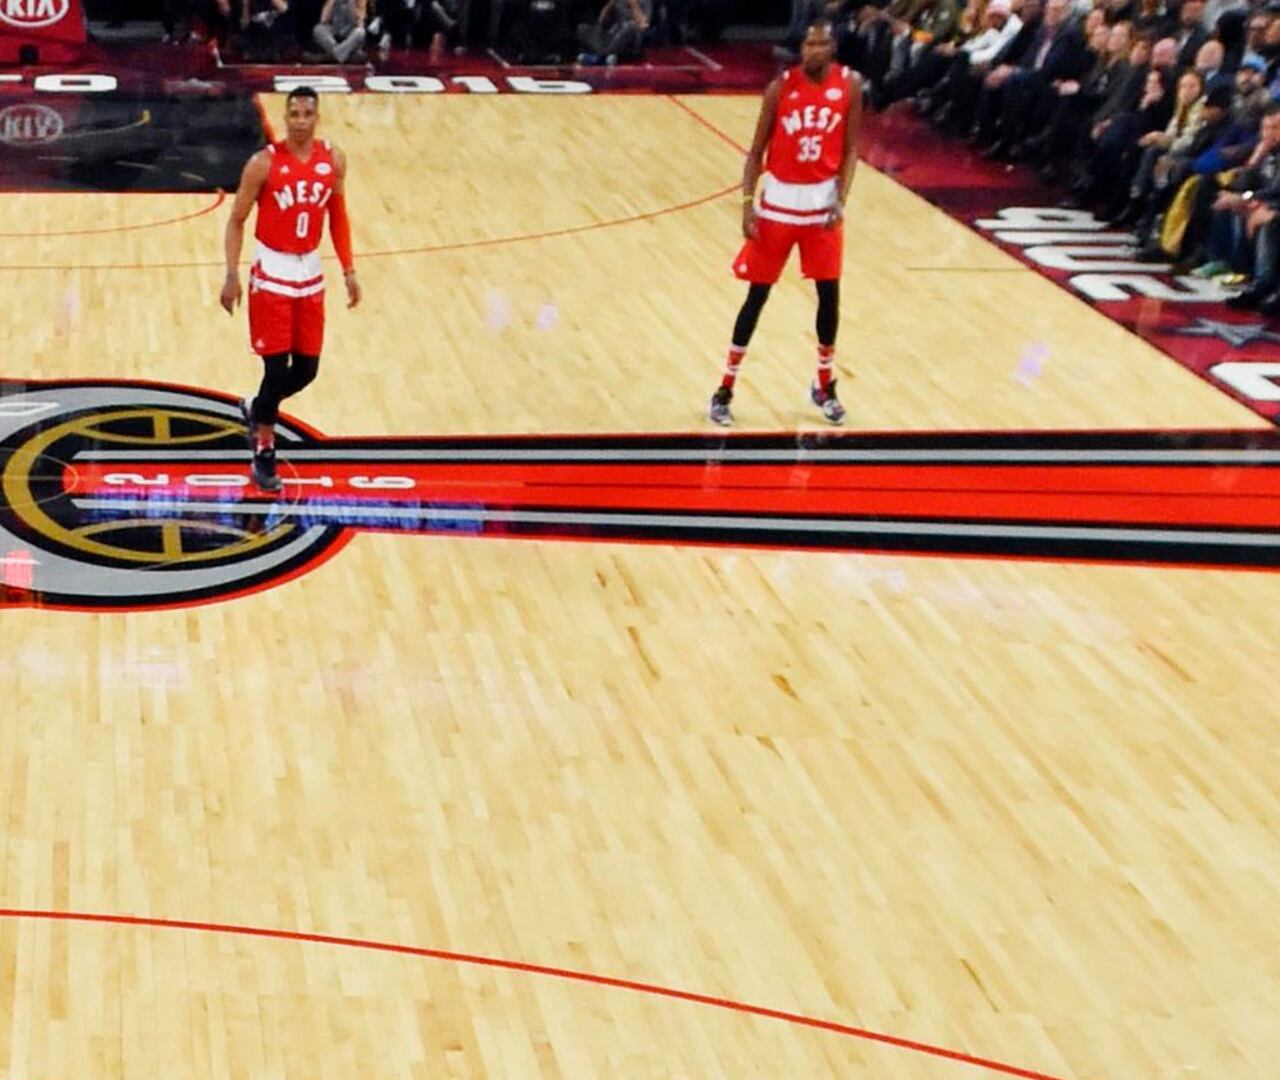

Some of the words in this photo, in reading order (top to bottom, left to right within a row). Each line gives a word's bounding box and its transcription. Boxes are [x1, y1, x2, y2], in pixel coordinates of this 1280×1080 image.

[5, 0, 57, 18] KIA
[781, 104, 842, 136] WEST
[798, 135, 823, 162] 35
[273, 180, 332, 210] WEST
[296, 211, 309, 238] 0
